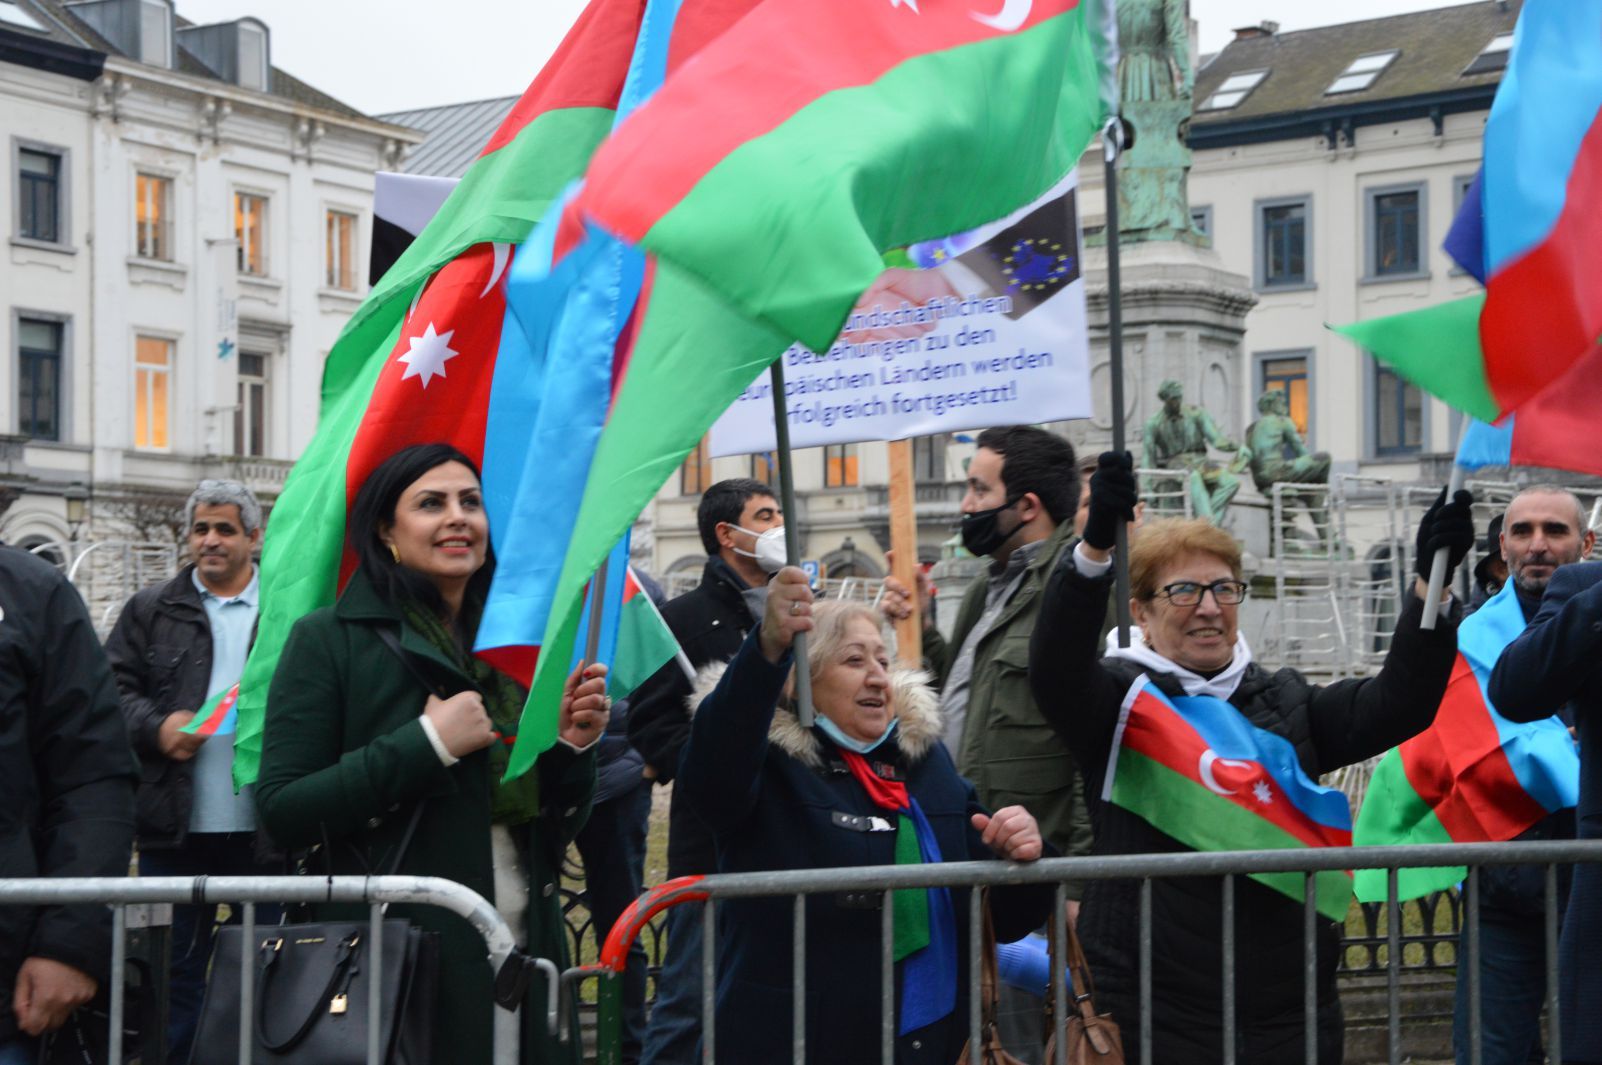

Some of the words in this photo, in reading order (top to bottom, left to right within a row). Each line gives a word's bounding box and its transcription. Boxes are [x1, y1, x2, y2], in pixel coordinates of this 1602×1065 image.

[843, 293, 1012, 331] undschaftlichen
[788, 338, 919, 366] Beehungen
[925, 335, 948, 352] zu
[954, 324, 996, 347] den
[738, 369, 875, 401] eurpäischen
[880, 360, 966, 386] Ländern
[972, 348, 1053, 373] werden
[772, 395, 886, 427] folgreich
[892, 380, 1017, 415] fortgesetzt!
